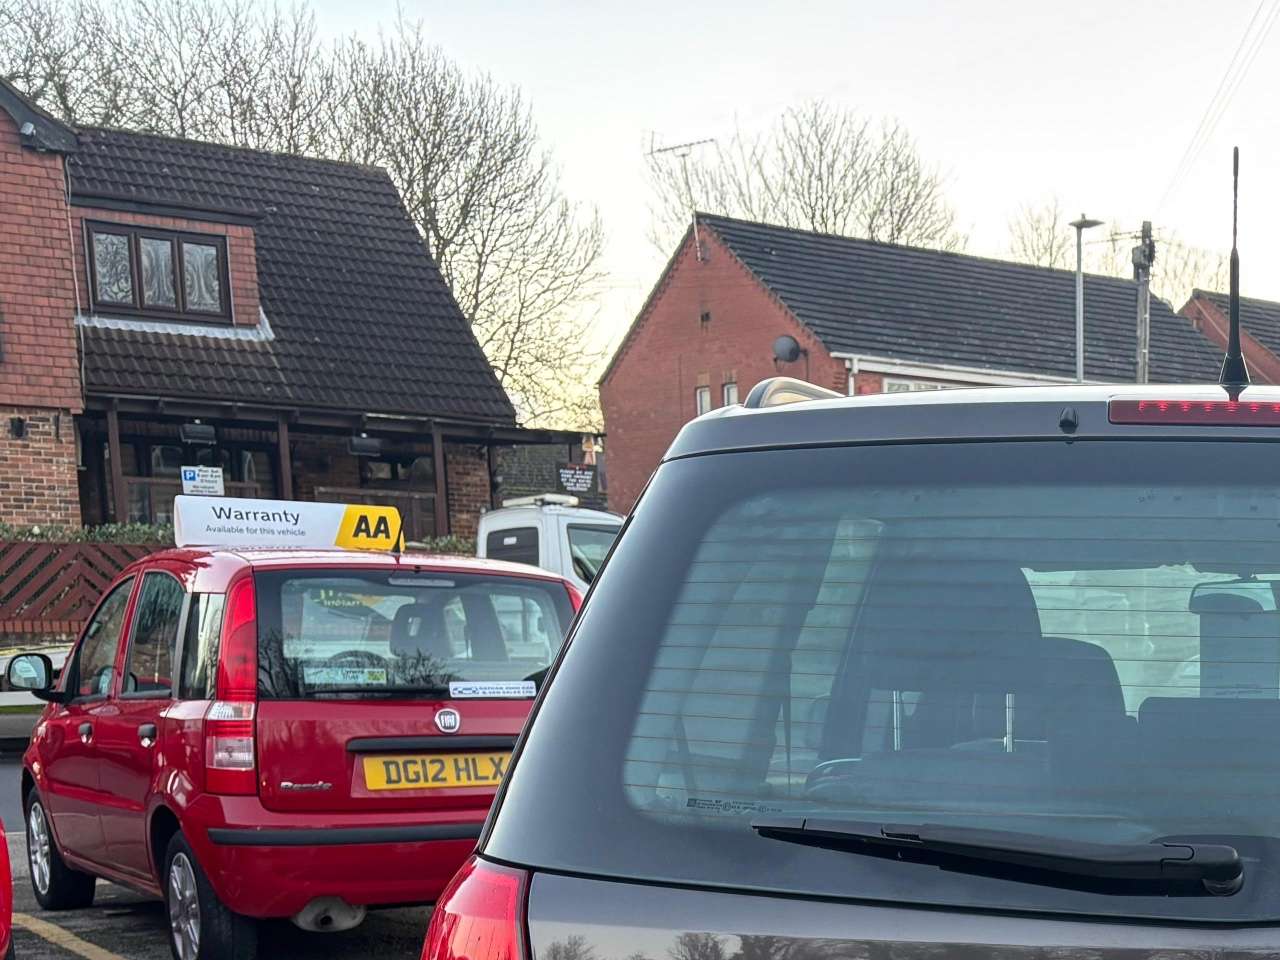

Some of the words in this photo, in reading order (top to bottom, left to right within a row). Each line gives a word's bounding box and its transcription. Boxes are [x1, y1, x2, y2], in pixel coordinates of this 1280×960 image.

[212, 506, 300, 526] Warranty
[352, 515, 391, 539] AA
[205, 525, 245, 535] Available
[246, 526, 258, 535] for
[260, 526, 276, 536] this
[277, 527, 306, 537] vehicle
[383, 760, 447, 785] DG12
[454, 756, 507, 781] HLX
